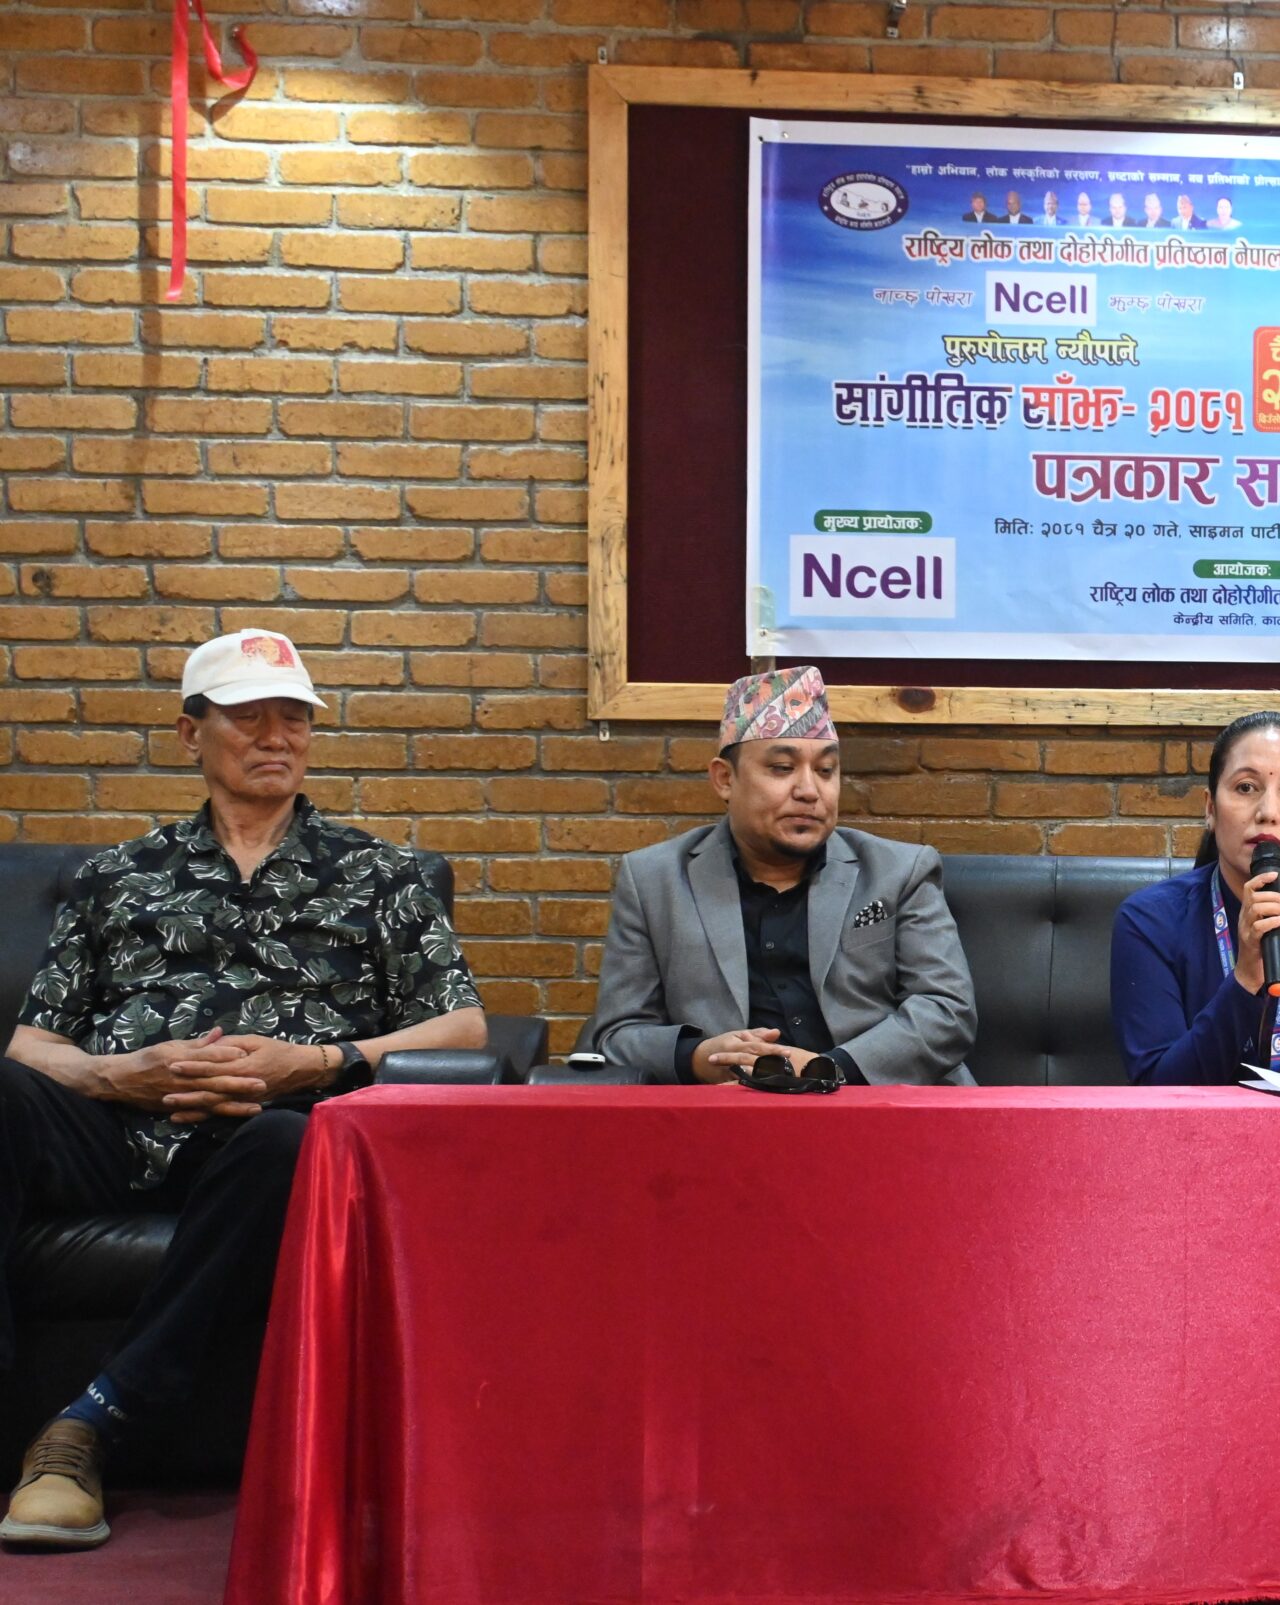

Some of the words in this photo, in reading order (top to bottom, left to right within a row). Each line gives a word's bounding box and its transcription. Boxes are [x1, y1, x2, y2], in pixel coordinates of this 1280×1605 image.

[986, 164, 1008, 177] लोक
[905, 230, 965, 264] राष्ट्रिय
[970, 232, 1013, 260] लोक
[1019, 240, 1053, 261] तथा
[1060, 235, 1149, 265] दोहोरीगीत
[1155, 237, 1228, 267] प्रतिष्ठान
[926, 287, 973, 305] पोखरा
[994, 281, 1088, 315] Ncell
[1157, 293, 1204, 312] पोखरा
[942, 330, 1049, 366] पुरुषोत्तम
[1056, 329, 1140, 366] न्यौपाने
[834, 373, 1013, 426] सांगीतिक
[1150, 390, 1244, 433] २०८१
[1032, 453, 1220, 506] पत्रकार
[823, 515, 859, 532] मुख्य
[1041, 522, 1084, 538] २०८१
[1092, 518, 1118, 537] चैत्र
[1124, 523, 1146, 539] २०
[1188, 524, 1244, 540] साइमन
[802, 552, 943, 600] Ncell
[1089, 581, 1137, 606] राष्ट्रिय
[1142, 583, 1175, 603] लोक
[1180, 587, 1208, 605] तथा
[1173, 611, 1214, 626] केन्द्रीय
